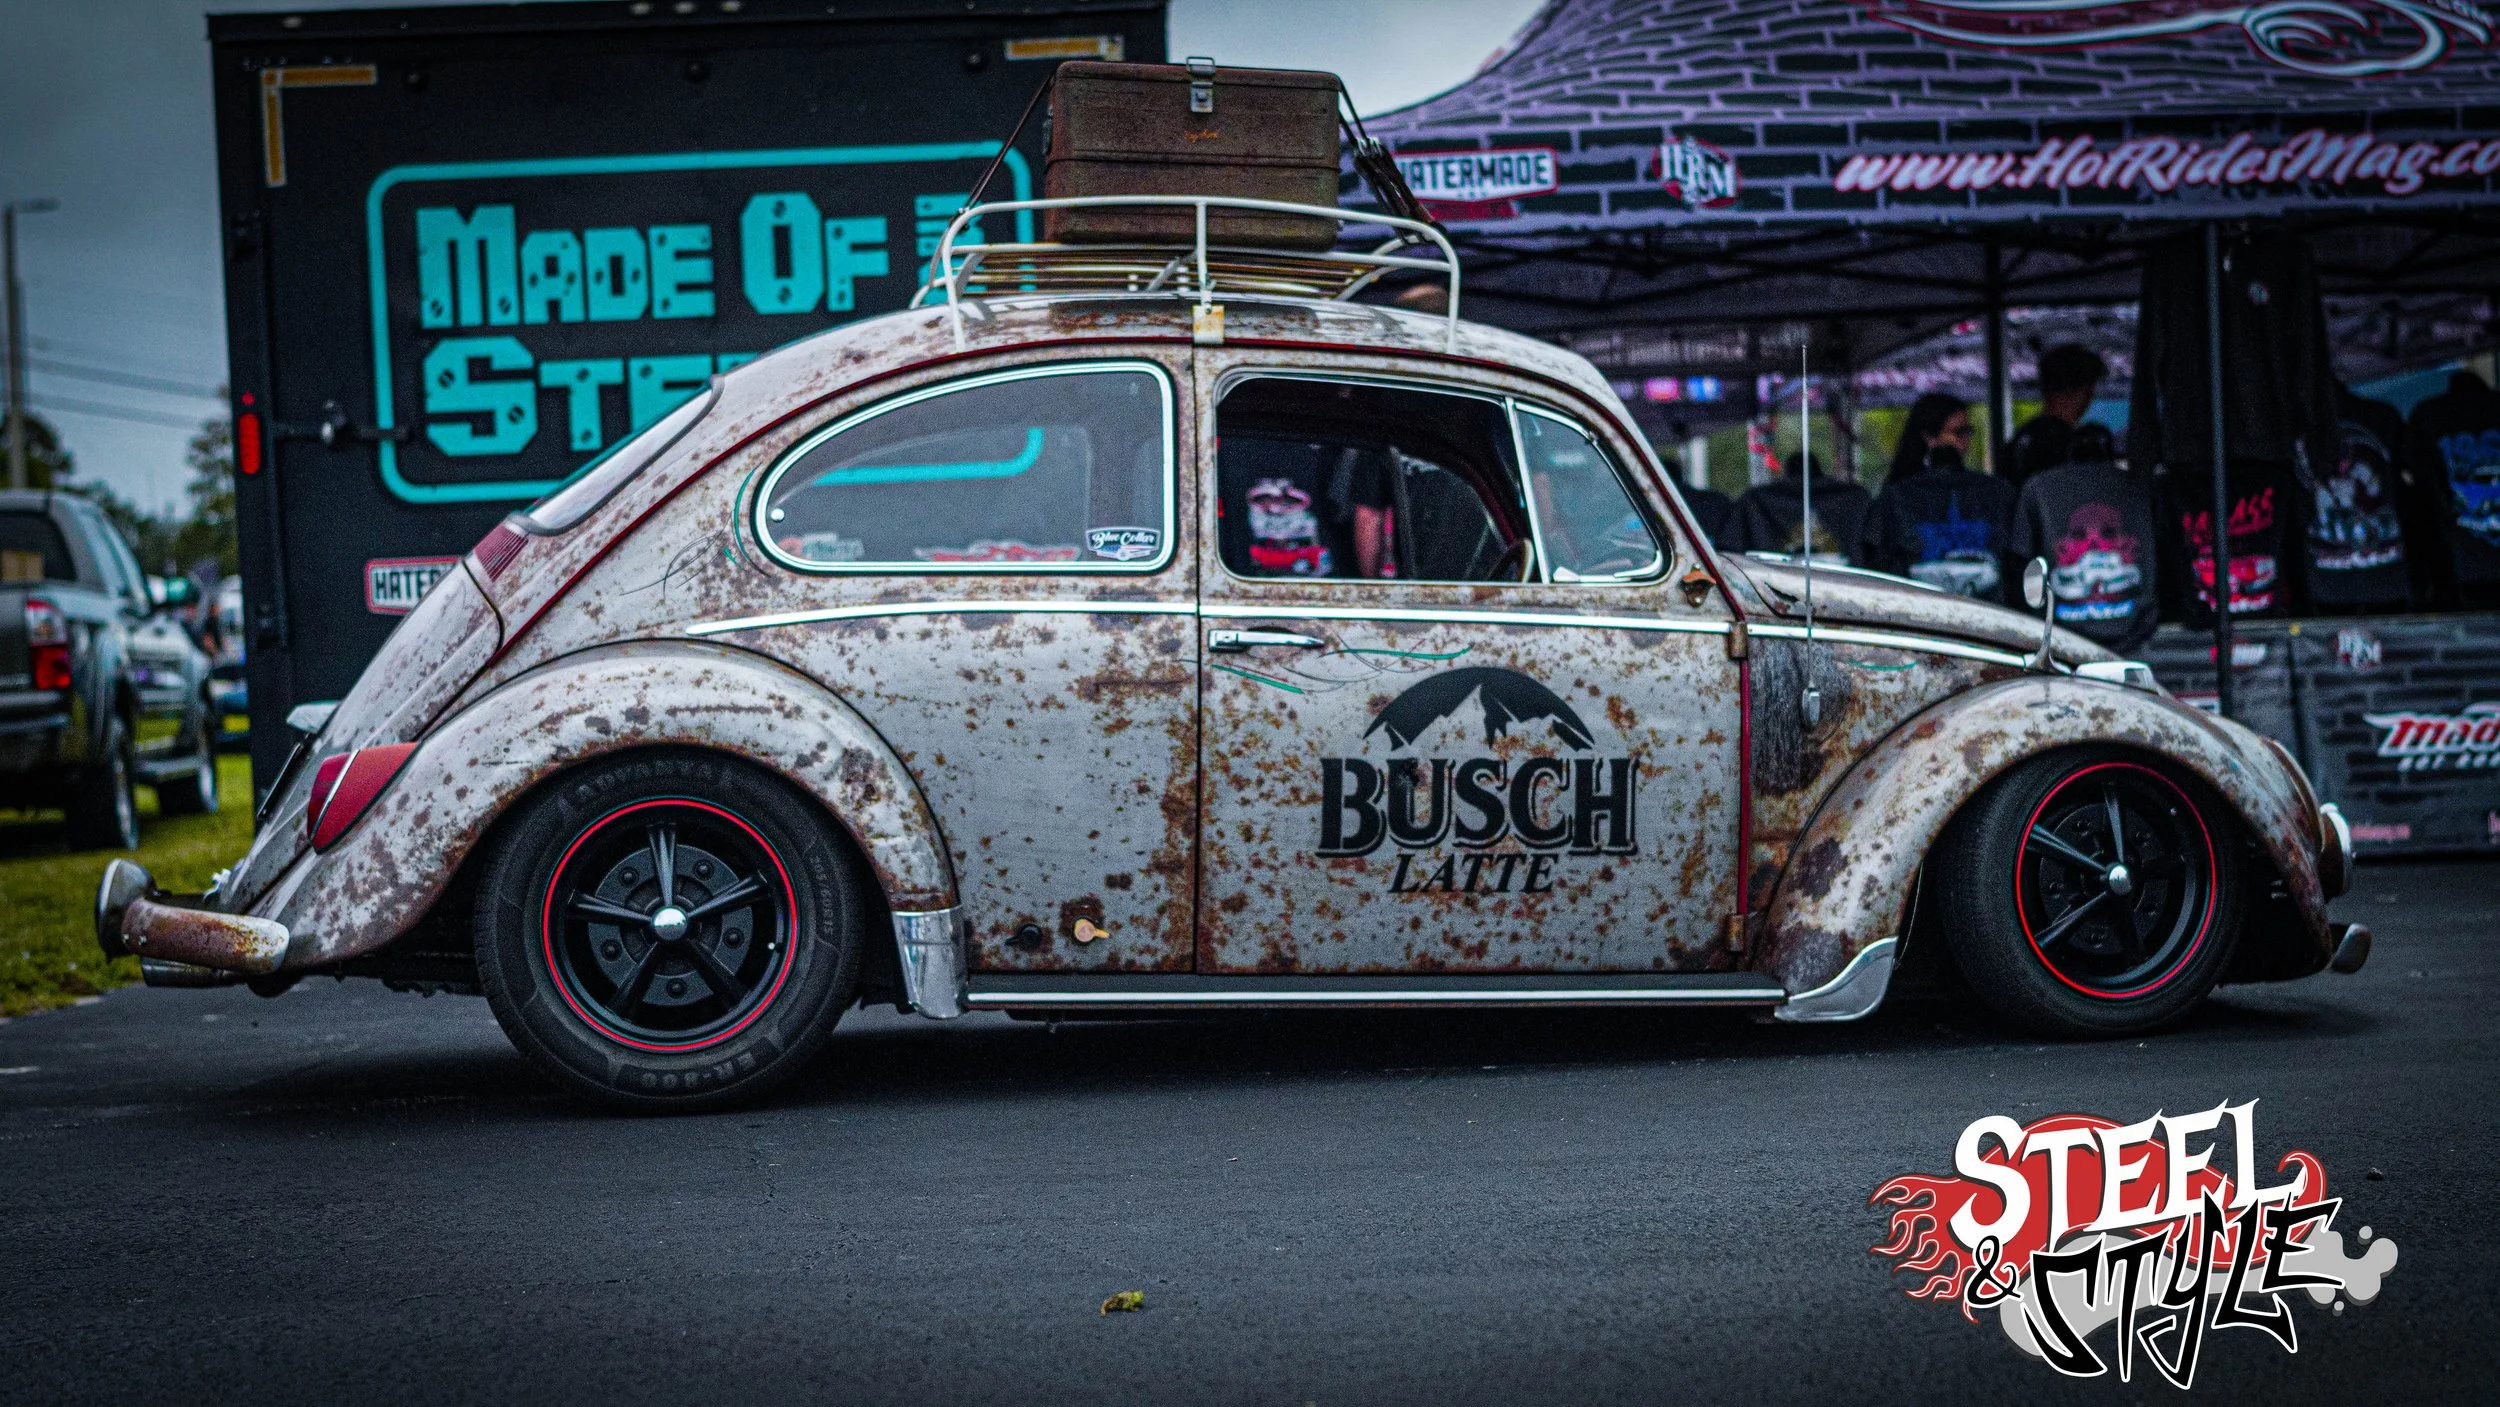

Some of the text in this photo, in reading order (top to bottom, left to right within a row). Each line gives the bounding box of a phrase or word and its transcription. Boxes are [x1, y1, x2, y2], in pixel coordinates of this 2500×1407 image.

[422, 335, 760, 456] STE
[1120, 531, 1155, 546] Collar
[1315, 757, 1640, 857] BUSCH
[1388, 853, 1559, 893] LATTE
